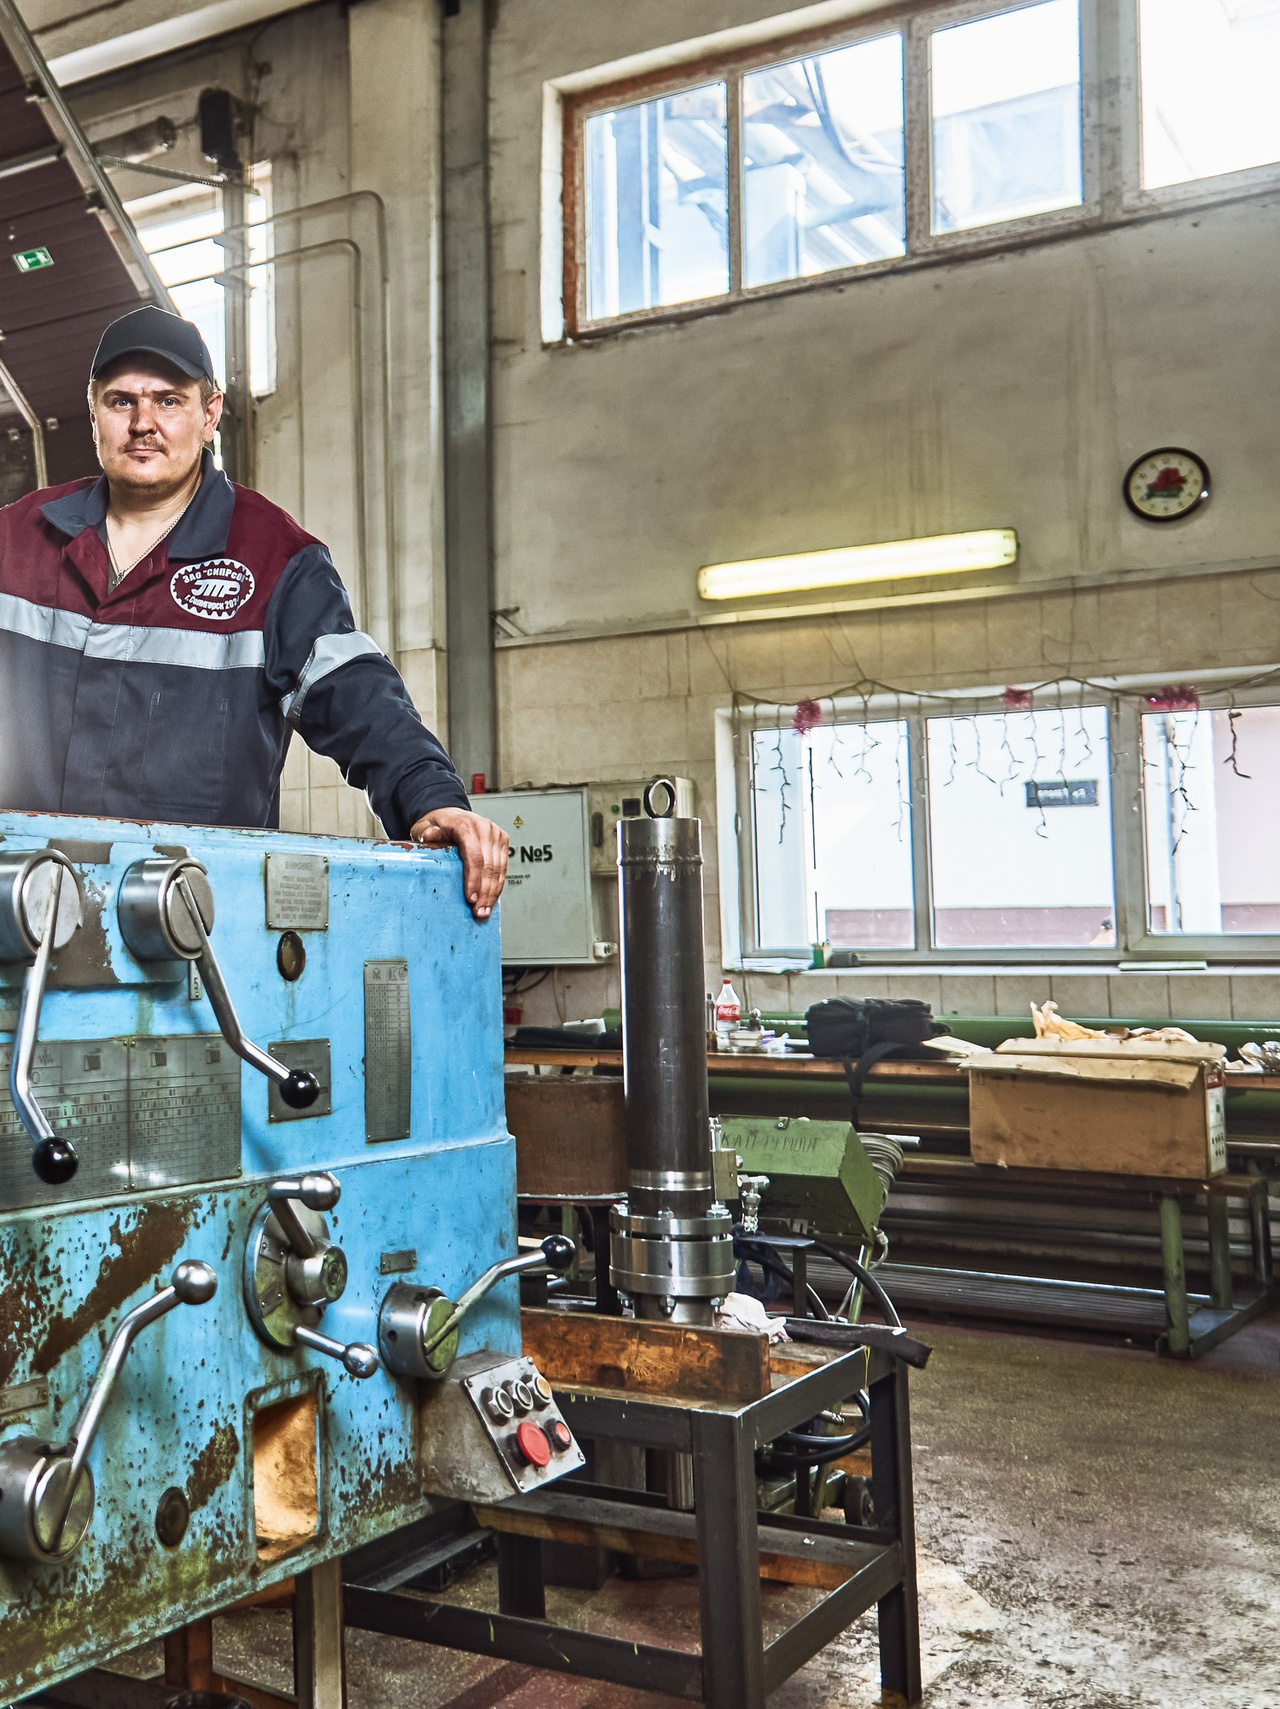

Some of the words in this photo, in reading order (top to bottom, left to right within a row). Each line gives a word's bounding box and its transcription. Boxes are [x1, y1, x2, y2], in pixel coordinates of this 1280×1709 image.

[183, 571, 202, 584] ЗАО
[521, 845, 553, 862] №5
[194, 977, 199, 990] 5
